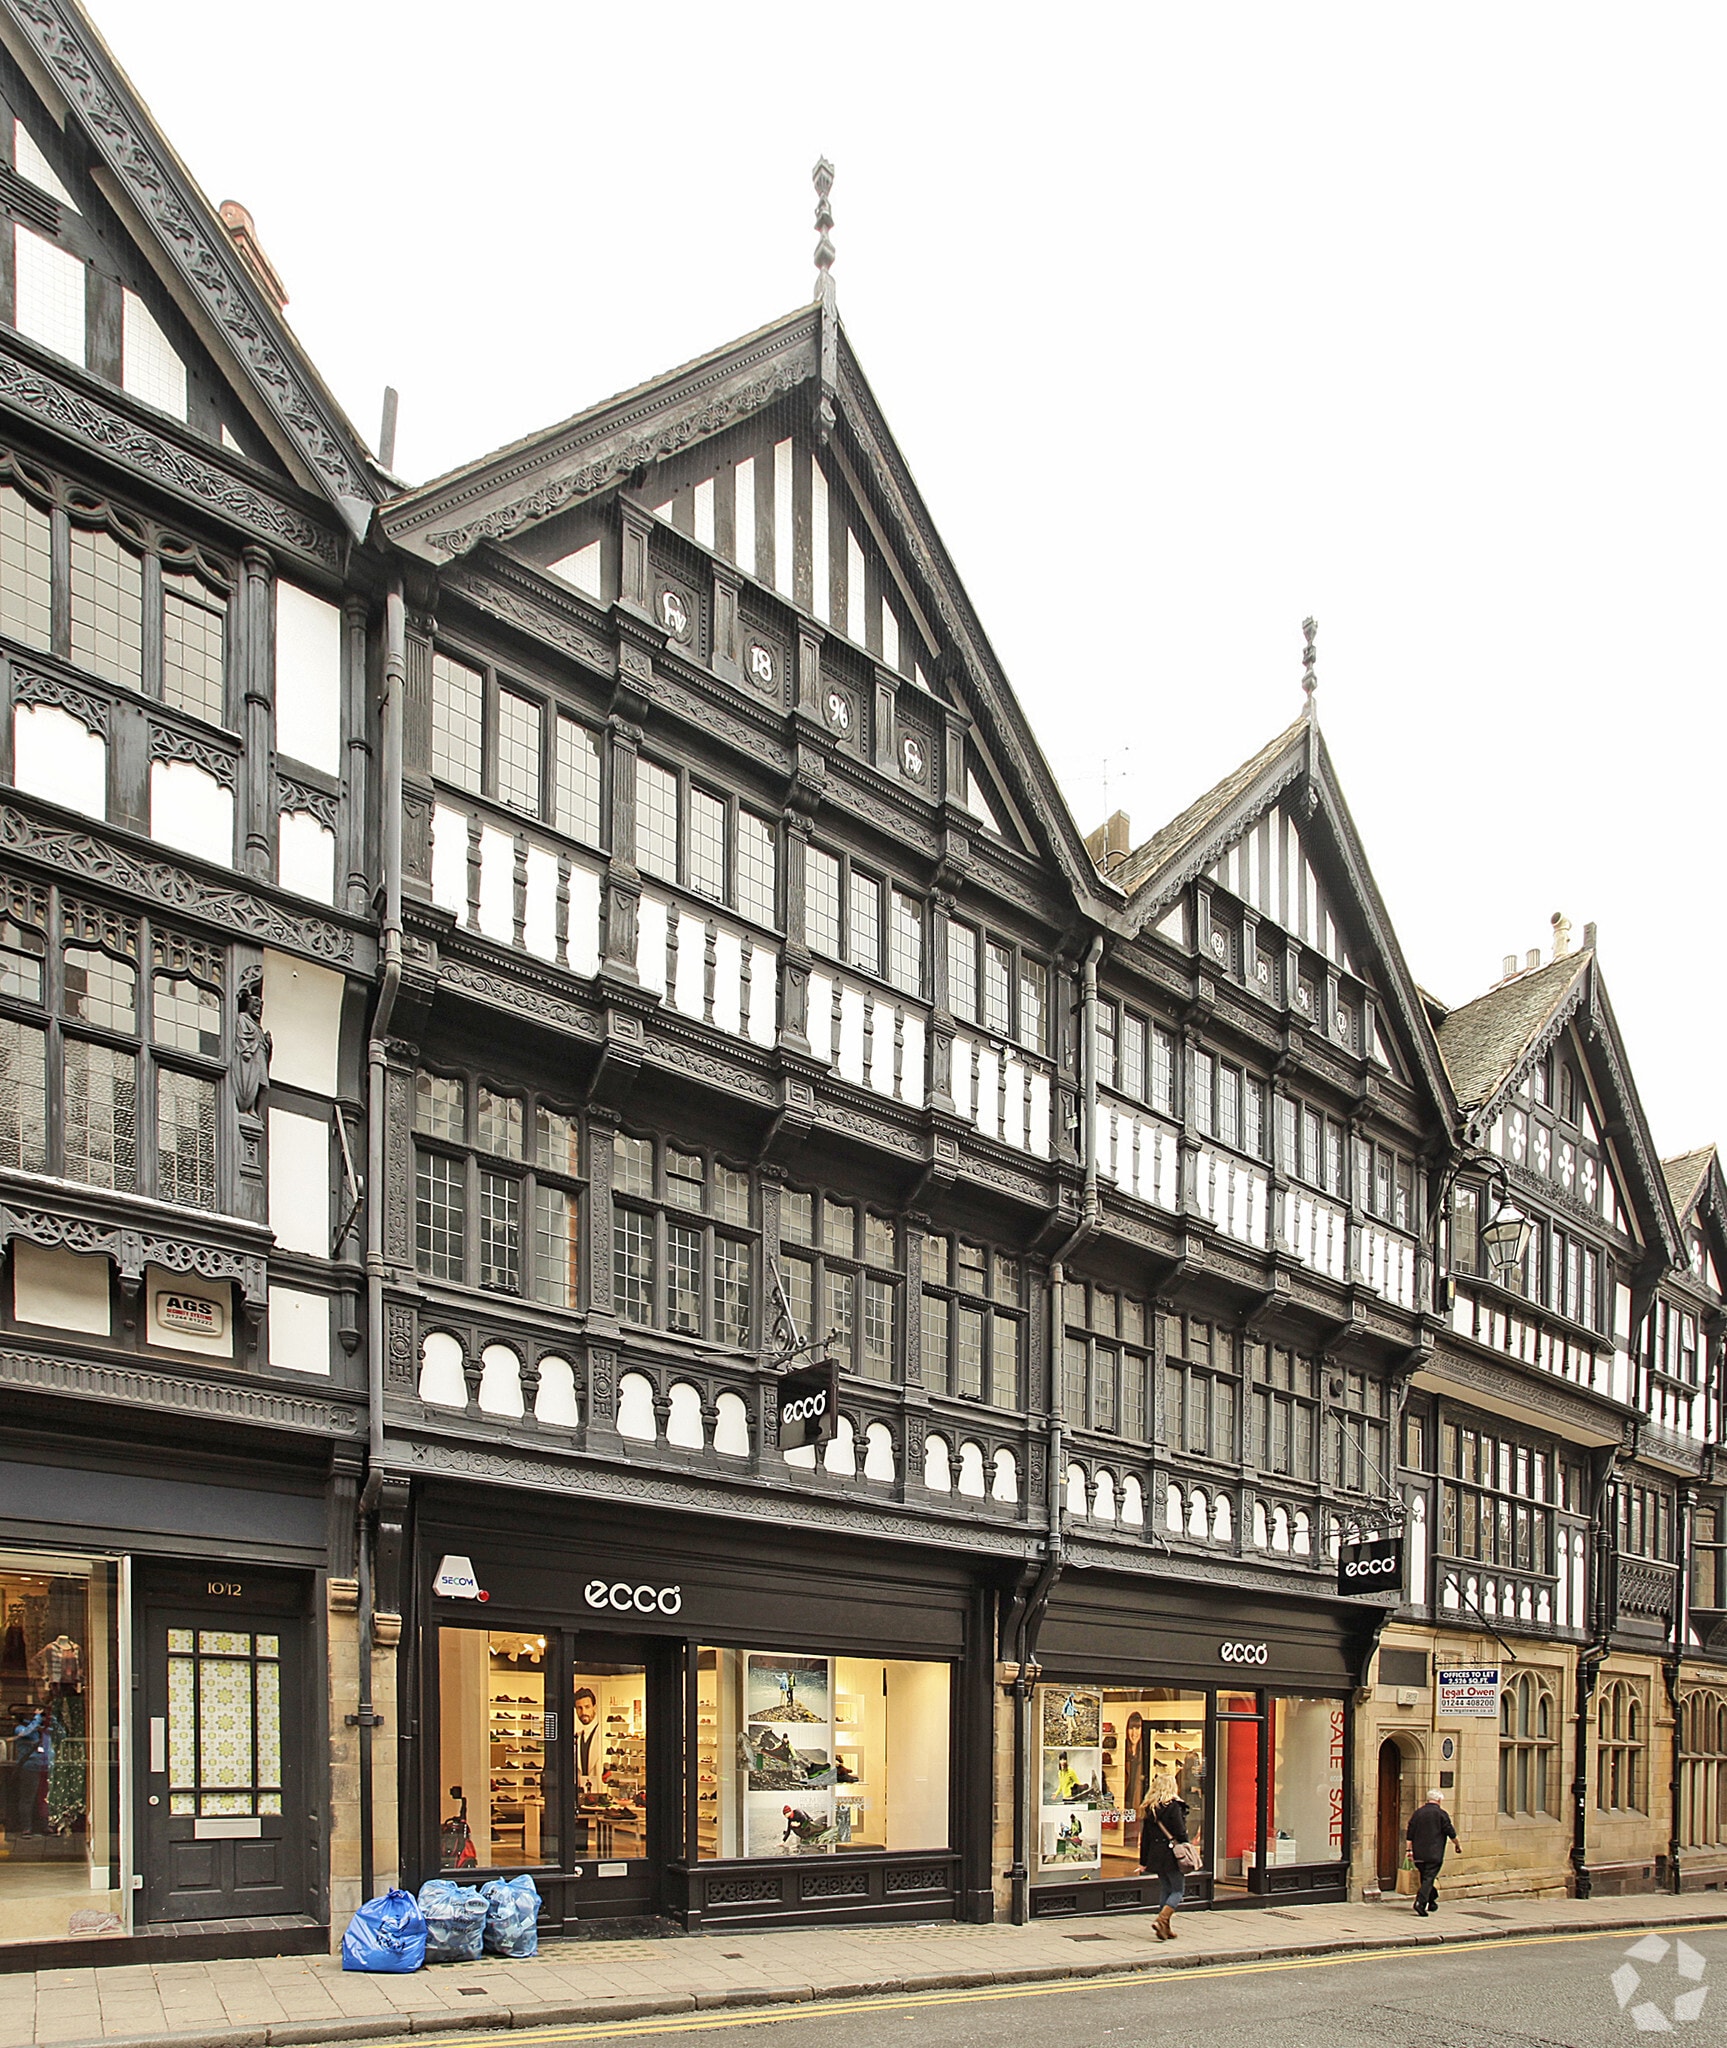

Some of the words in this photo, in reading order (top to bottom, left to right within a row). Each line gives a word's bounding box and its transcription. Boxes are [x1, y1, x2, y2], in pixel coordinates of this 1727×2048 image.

[751, 645, 773, 682] 18
[1257, 961, 1268, 984] 18
[166, 1297, 212, 1315] AGS
[783, 1390, 826, 1424] ecco
[1345, 1555, 1396, 1577] ecco
[441, 1576, 474, 1586] SECOM
[585, 1580, 682, 1615] ecco
[1221, 1641, 1268, 1665] ecco
[1443, 1671, 1470, 1679] OFFICES
[1441, 1687, 1464, 1699] Legat
[1467, 1687, 1495, 1696] Owen
[1330, 1710, 1344, 1769] SALE
[1329, 1788, 1344, 1847] SALE
